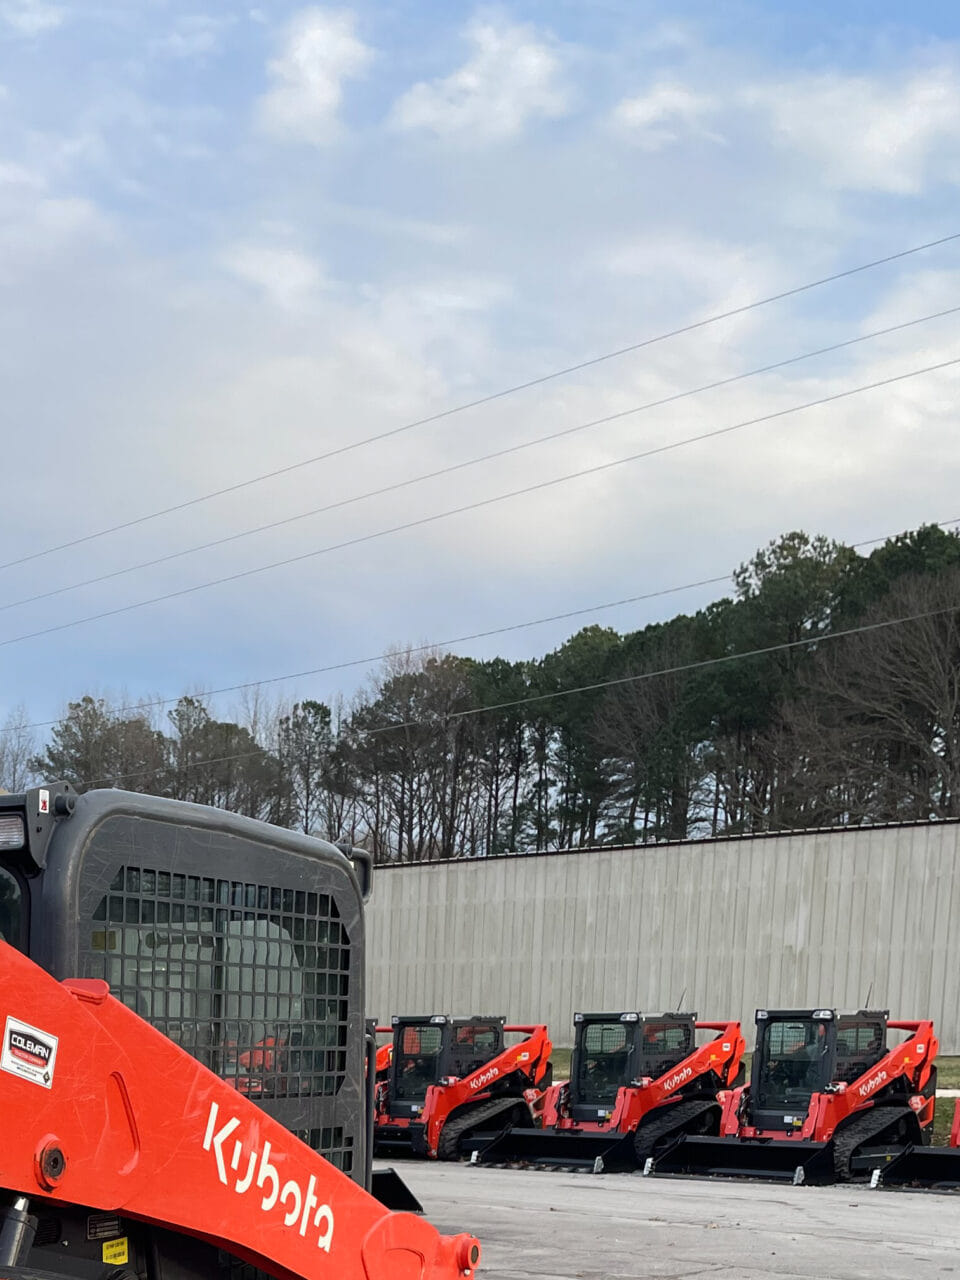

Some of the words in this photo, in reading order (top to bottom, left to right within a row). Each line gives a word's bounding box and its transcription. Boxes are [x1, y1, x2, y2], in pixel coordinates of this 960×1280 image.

[11, 1035, 49, 1058] COLEMAN
[470, 1067, 499, 1089] Kubota
[664, 1066, 692, 1090] Kubota
[859, 1070, 887, 1097] Kubota
[202, 1101, 334, 1254] Kubota
